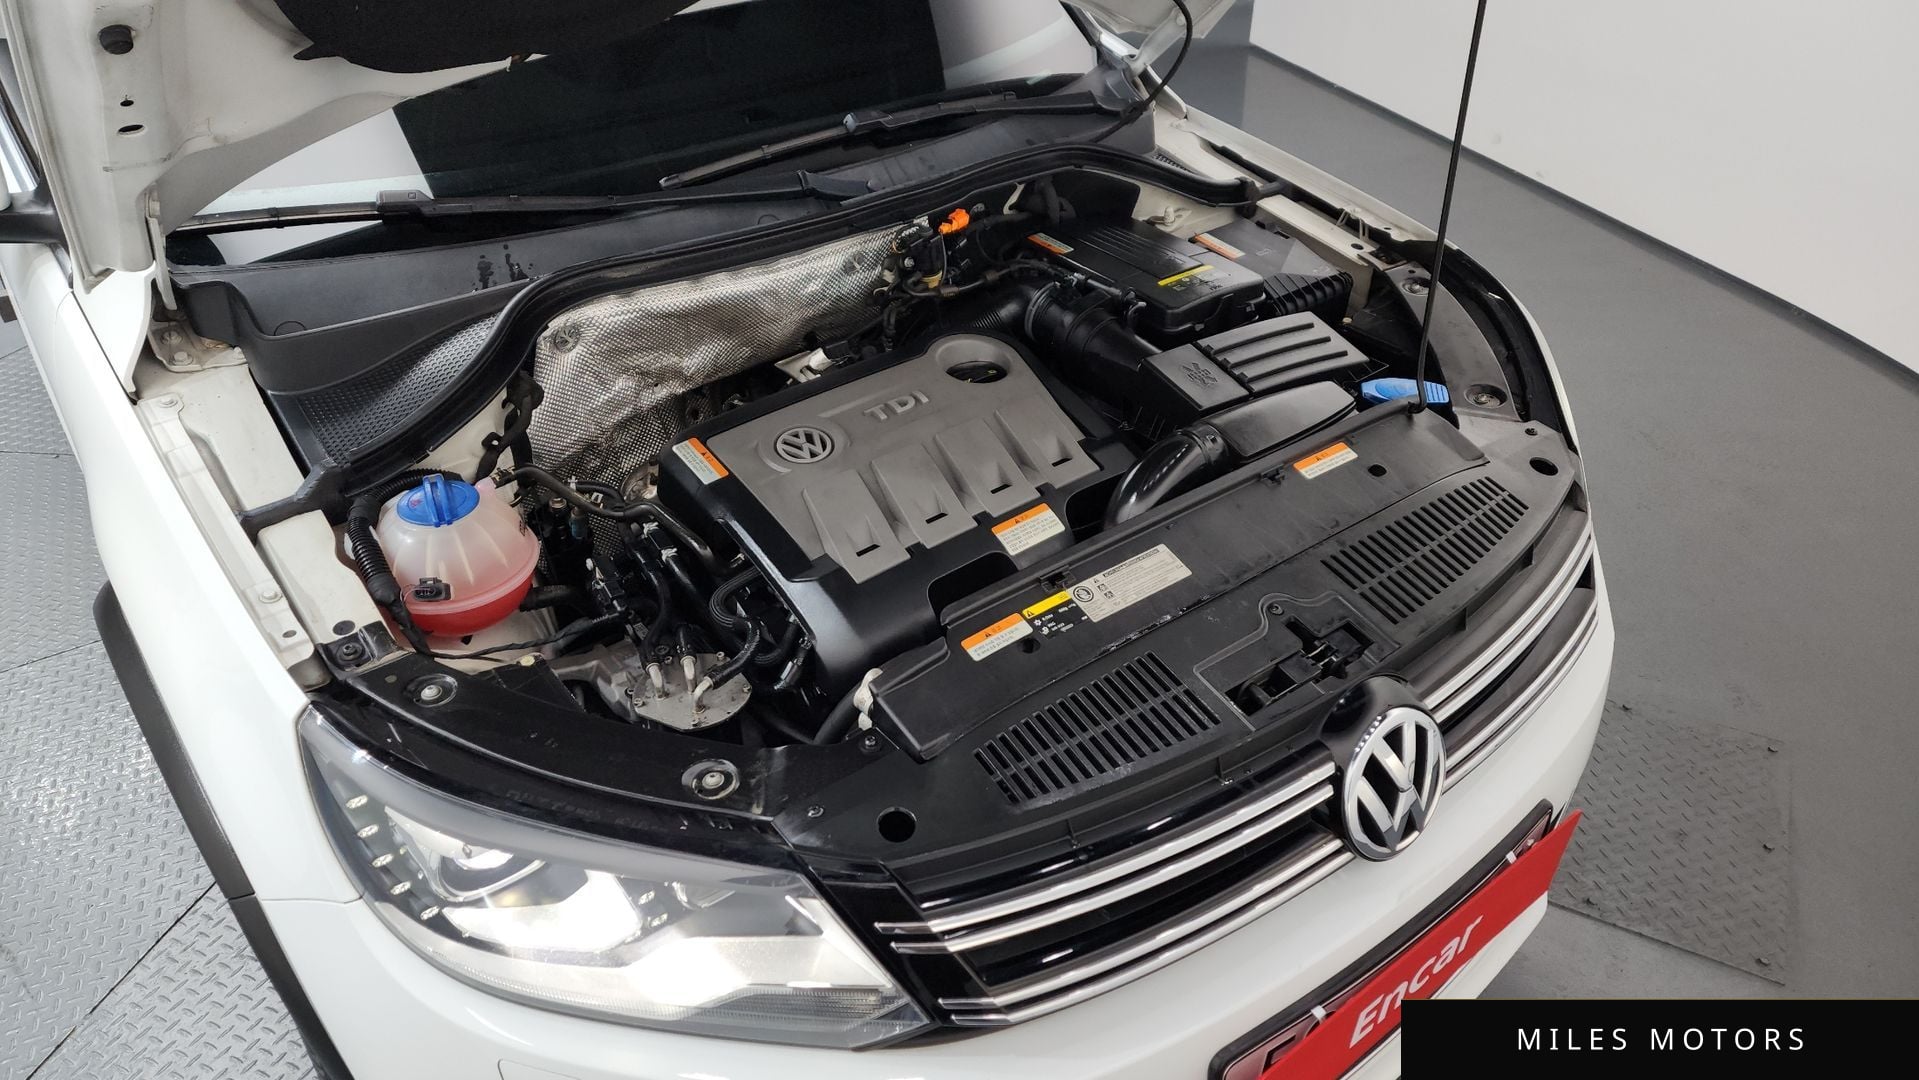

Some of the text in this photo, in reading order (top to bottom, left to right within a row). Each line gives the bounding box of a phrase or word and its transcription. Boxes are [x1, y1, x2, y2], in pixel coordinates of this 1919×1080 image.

[777, 428, 832, 463] VW
[863, 390, 930, 421] TDI
[1346, 707, 1445, 858] VW
[1349, 914, 1485, 1049] Encar
